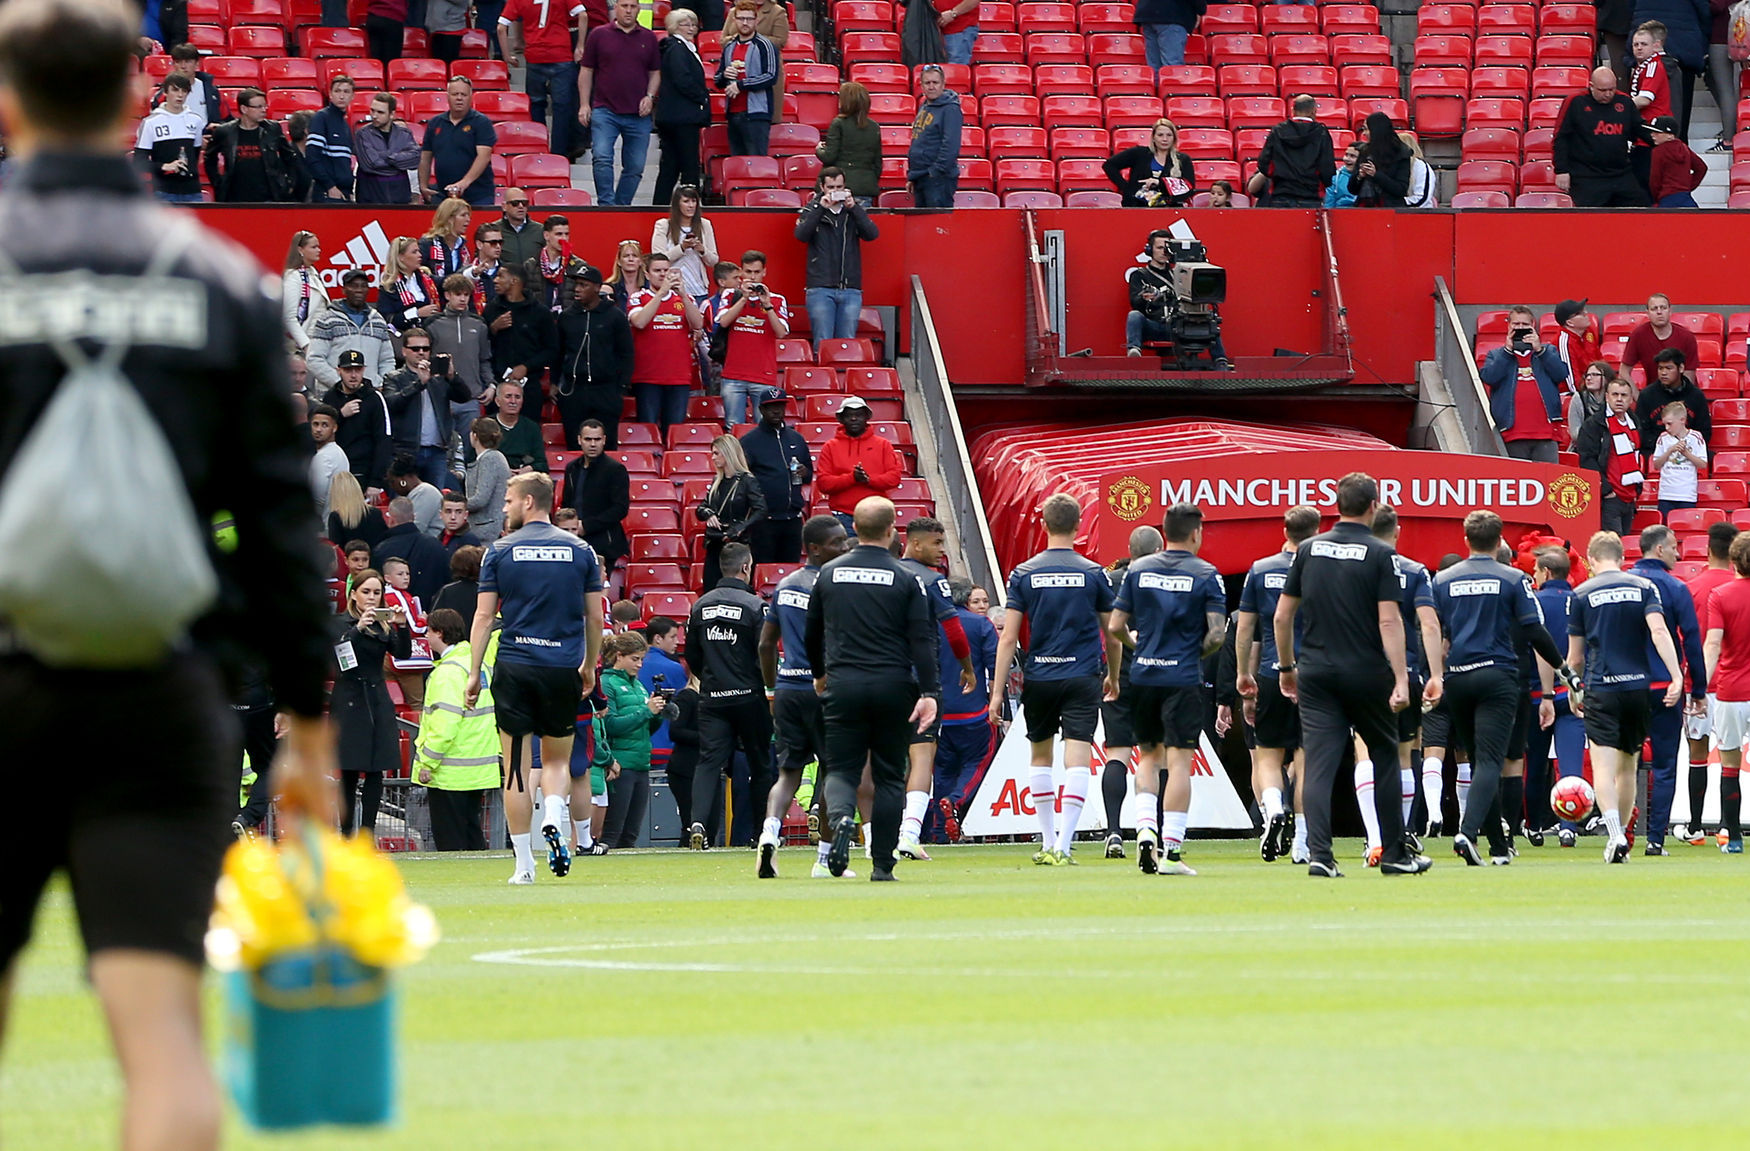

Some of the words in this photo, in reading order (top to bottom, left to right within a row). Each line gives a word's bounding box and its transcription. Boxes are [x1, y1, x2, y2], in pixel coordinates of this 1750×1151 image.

[156, 124, 170, 138] 03
[1594, 120, 1623, 135] AON
[351, 352, 358, 360] P
[1111, 478, 1148, 496] MANCHESTER
[1551, 475, 1588, 493] MANCHESTER
[1161, 479, 1403, 508] MANCHESR
[1413, 480, 1544, 506] UNITED
[1117, 507, 1144, 519] UNITED
[1557, 505, 1583, 518] UNITED
[514, 547, 572, 561] carbrini
[834, 568, 894, 586] carbrini
[1031, 574, 1084, 587] carbrini
[1139, 574, 1193, 592] carbrini
[1451, 580, 1499, 596] carbrini
[1589, 587, 1641, 607] carbrini
[703, 604, 742, 621] carbrini
[707, 625, 738, 645] Vitality
